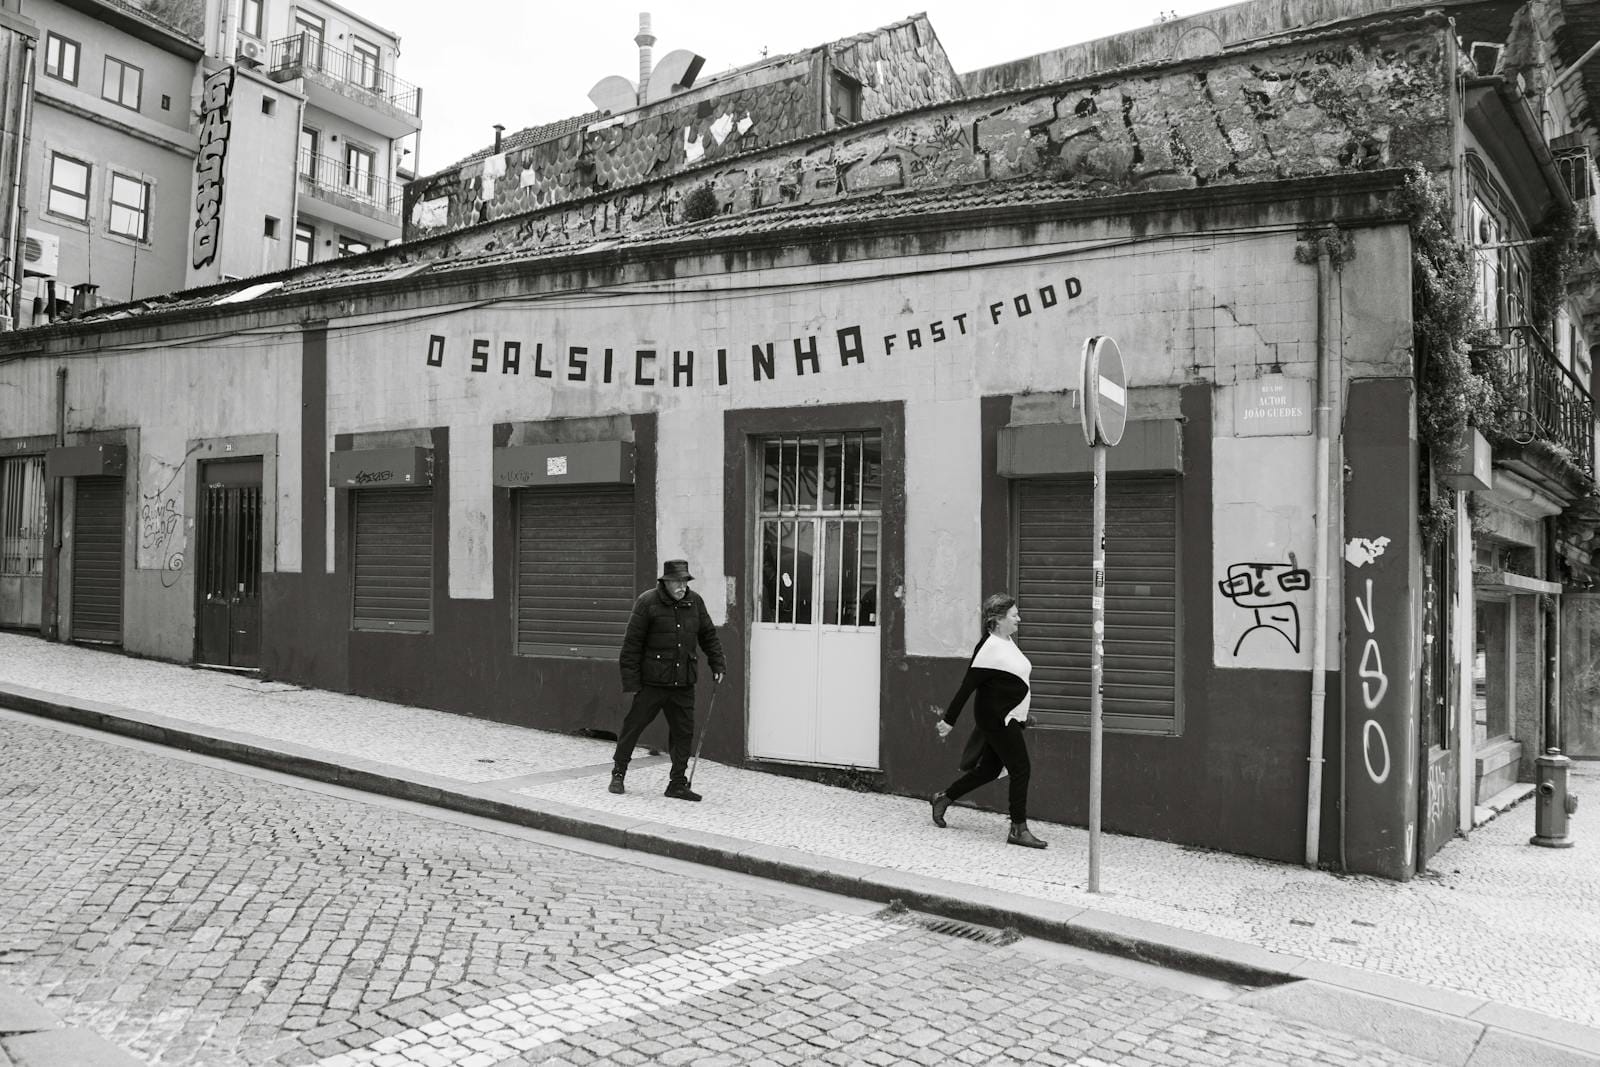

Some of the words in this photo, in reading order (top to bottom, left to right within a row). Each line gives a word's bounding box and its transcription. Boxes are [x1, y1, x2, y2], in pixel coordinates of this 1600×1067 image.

[426, 334, 446, 368] O
[471, 325, 865, 388] SALSICHINHA
[883, 312, 967, 356] FAST
[989, 277, 1082, 325] FOOD
[1259, 396, 1287, 406] ACTOR
[1243, 407, 1265, 420] JOÃO
[1267, 407, 1304, 418] GUEDES
